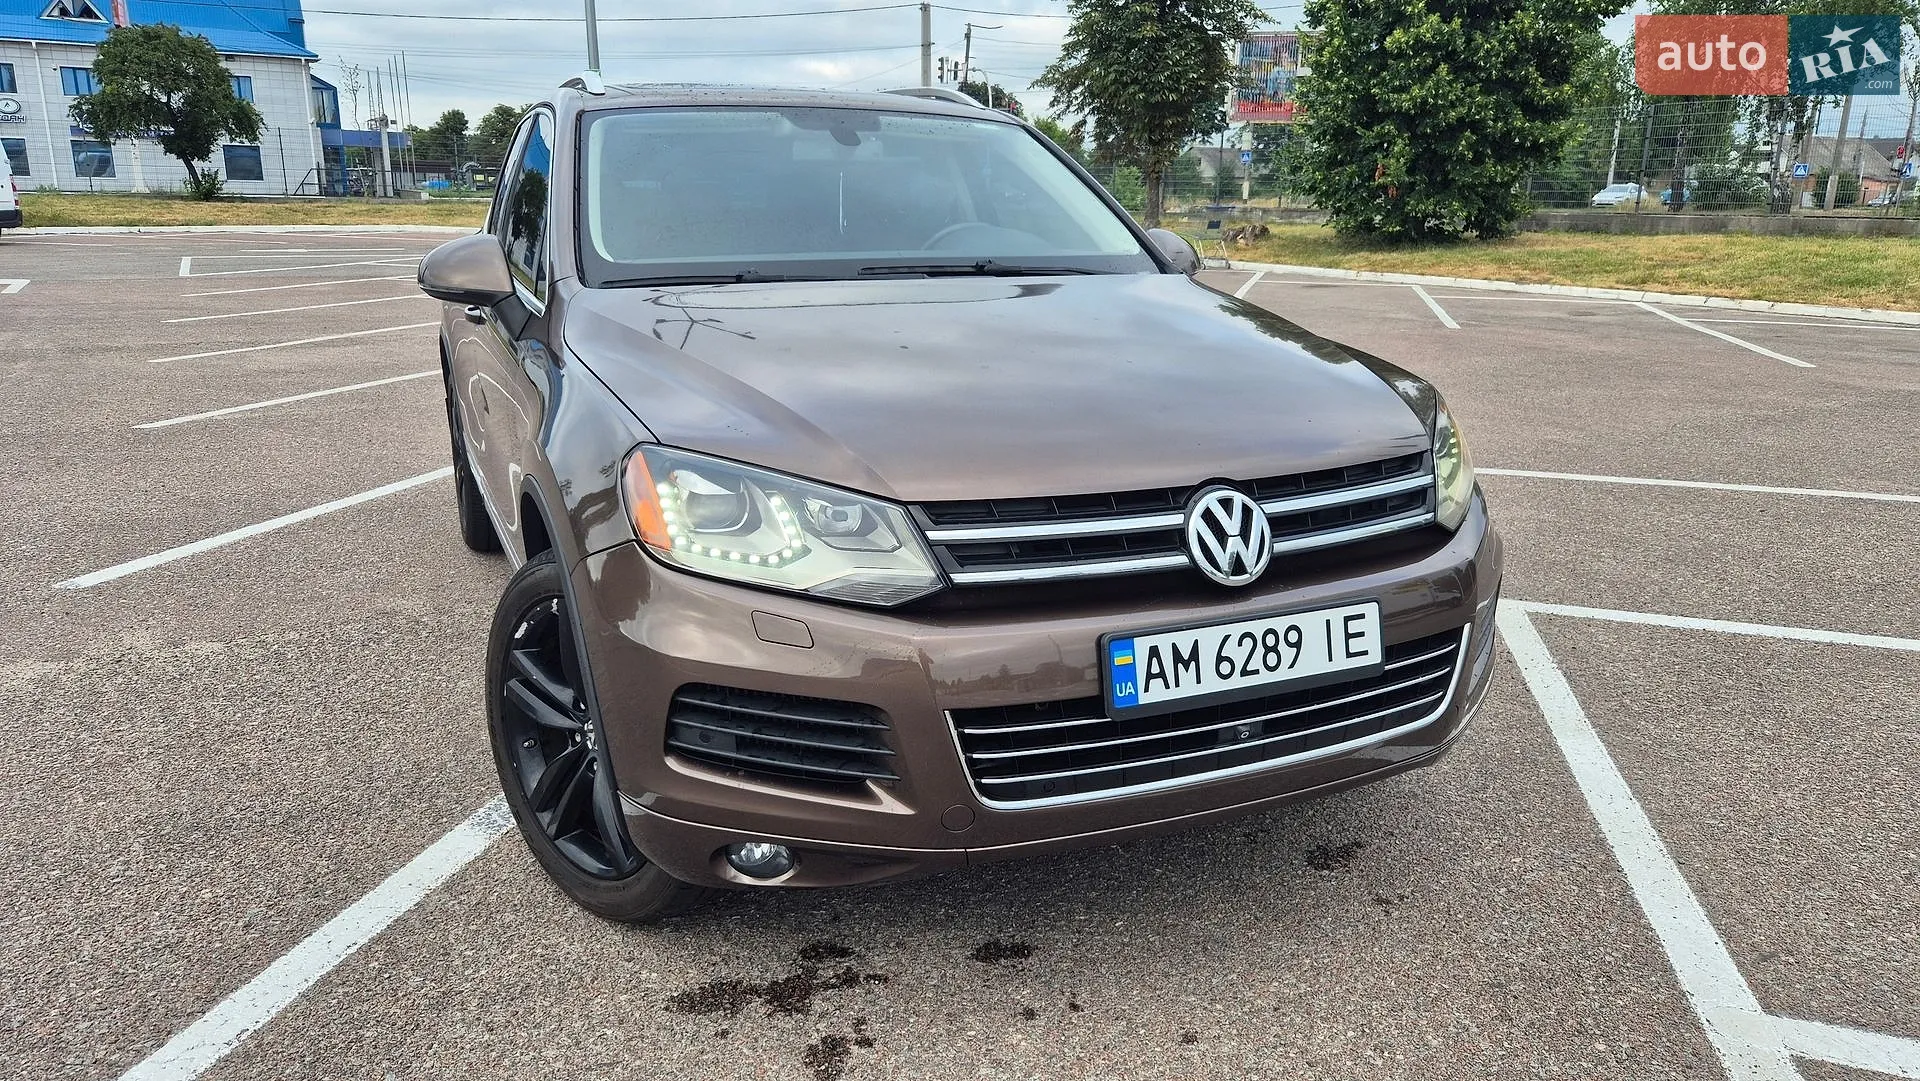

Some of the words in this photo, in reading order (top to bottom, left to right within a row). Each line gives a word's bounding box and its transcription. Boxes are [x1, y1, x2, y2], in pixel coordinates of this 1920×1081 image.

[1143, 640, 1202, 694] AM
[1214, 625, 1302, 681] 6289
[1325, 613, 1368, 663] IE
[1116, 683, 1136, 697] UA
